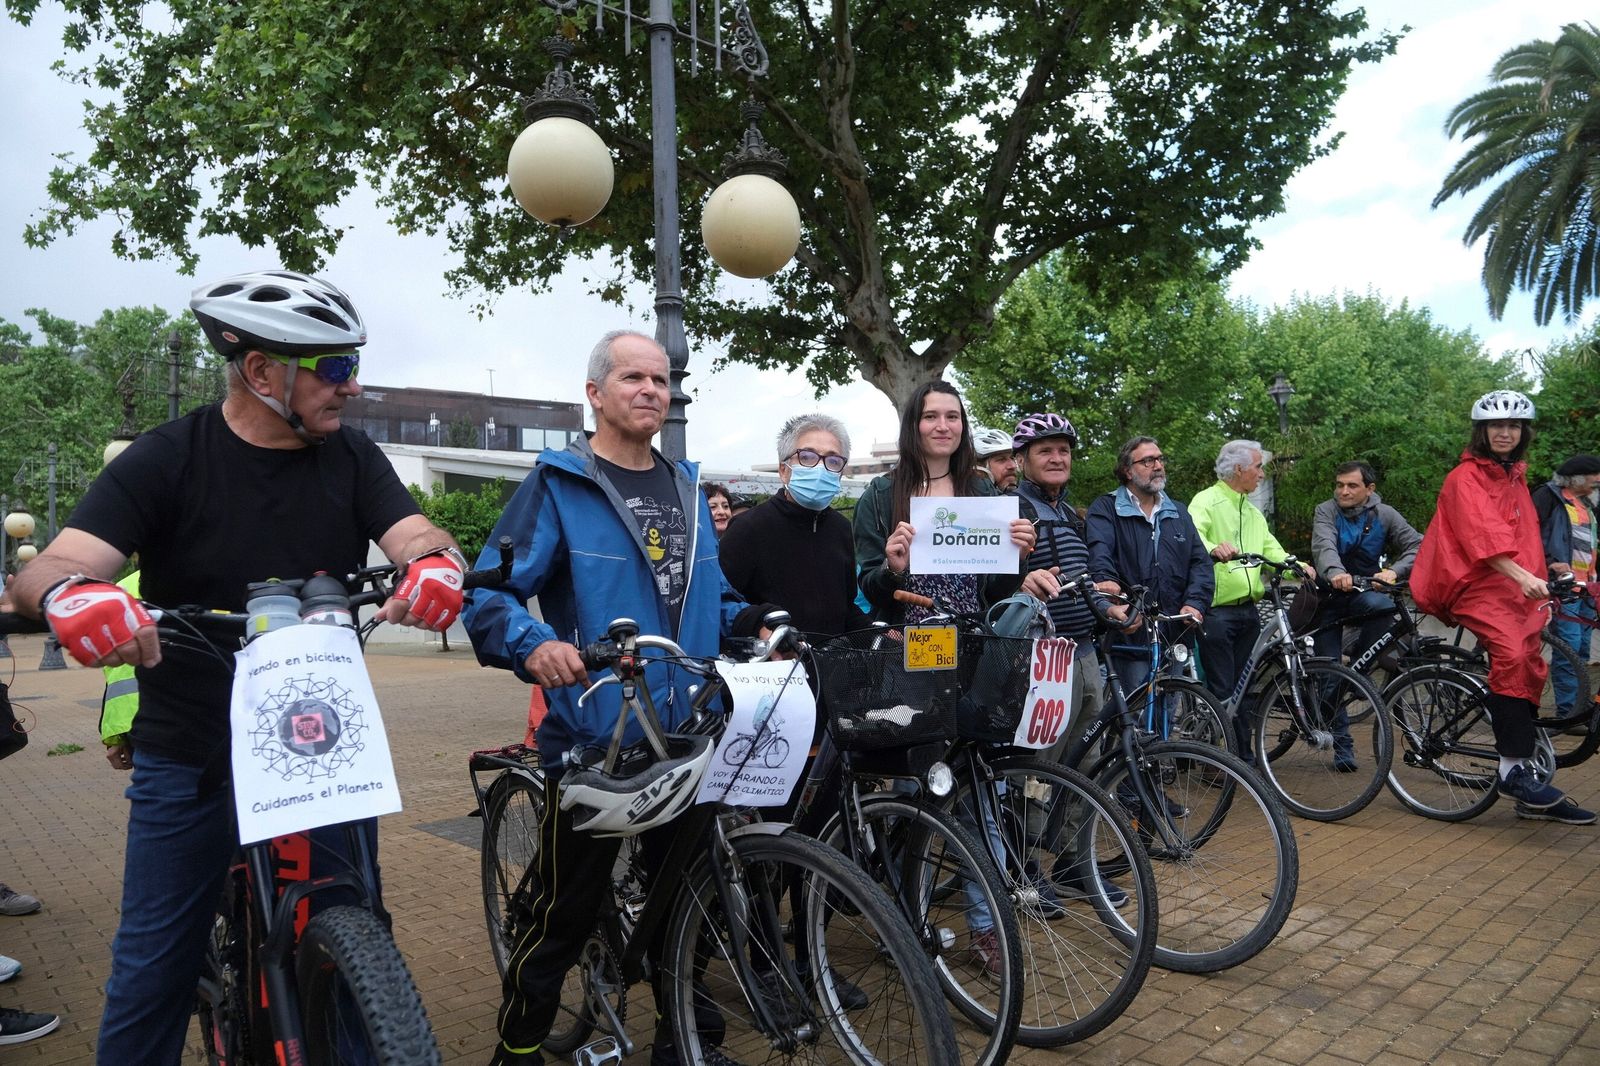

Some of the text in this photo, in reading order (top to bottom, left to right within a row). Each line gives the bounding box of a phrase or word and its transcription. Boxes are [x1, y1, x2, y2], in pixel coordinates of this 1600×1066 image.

[933, 533, 1000, 546] Doñana
[909, 631, 932, 646] Mejor
[928, 643, 943, 652] CON
[285, 657, 301, 666] en
[306, 653, 352, 664] bicicleta
[936, 653, 955, 665] Bici
[1033, 637, 1075, 683] STOP
[752, 676, 770, 684] VOY
[1027, 698, 1065, 745] CO2
[730, 770, 777, 785] PARANDO
[252, 781, 383, 813] Cuidamos el Planeta
[626, 772, 675, 824] MET
